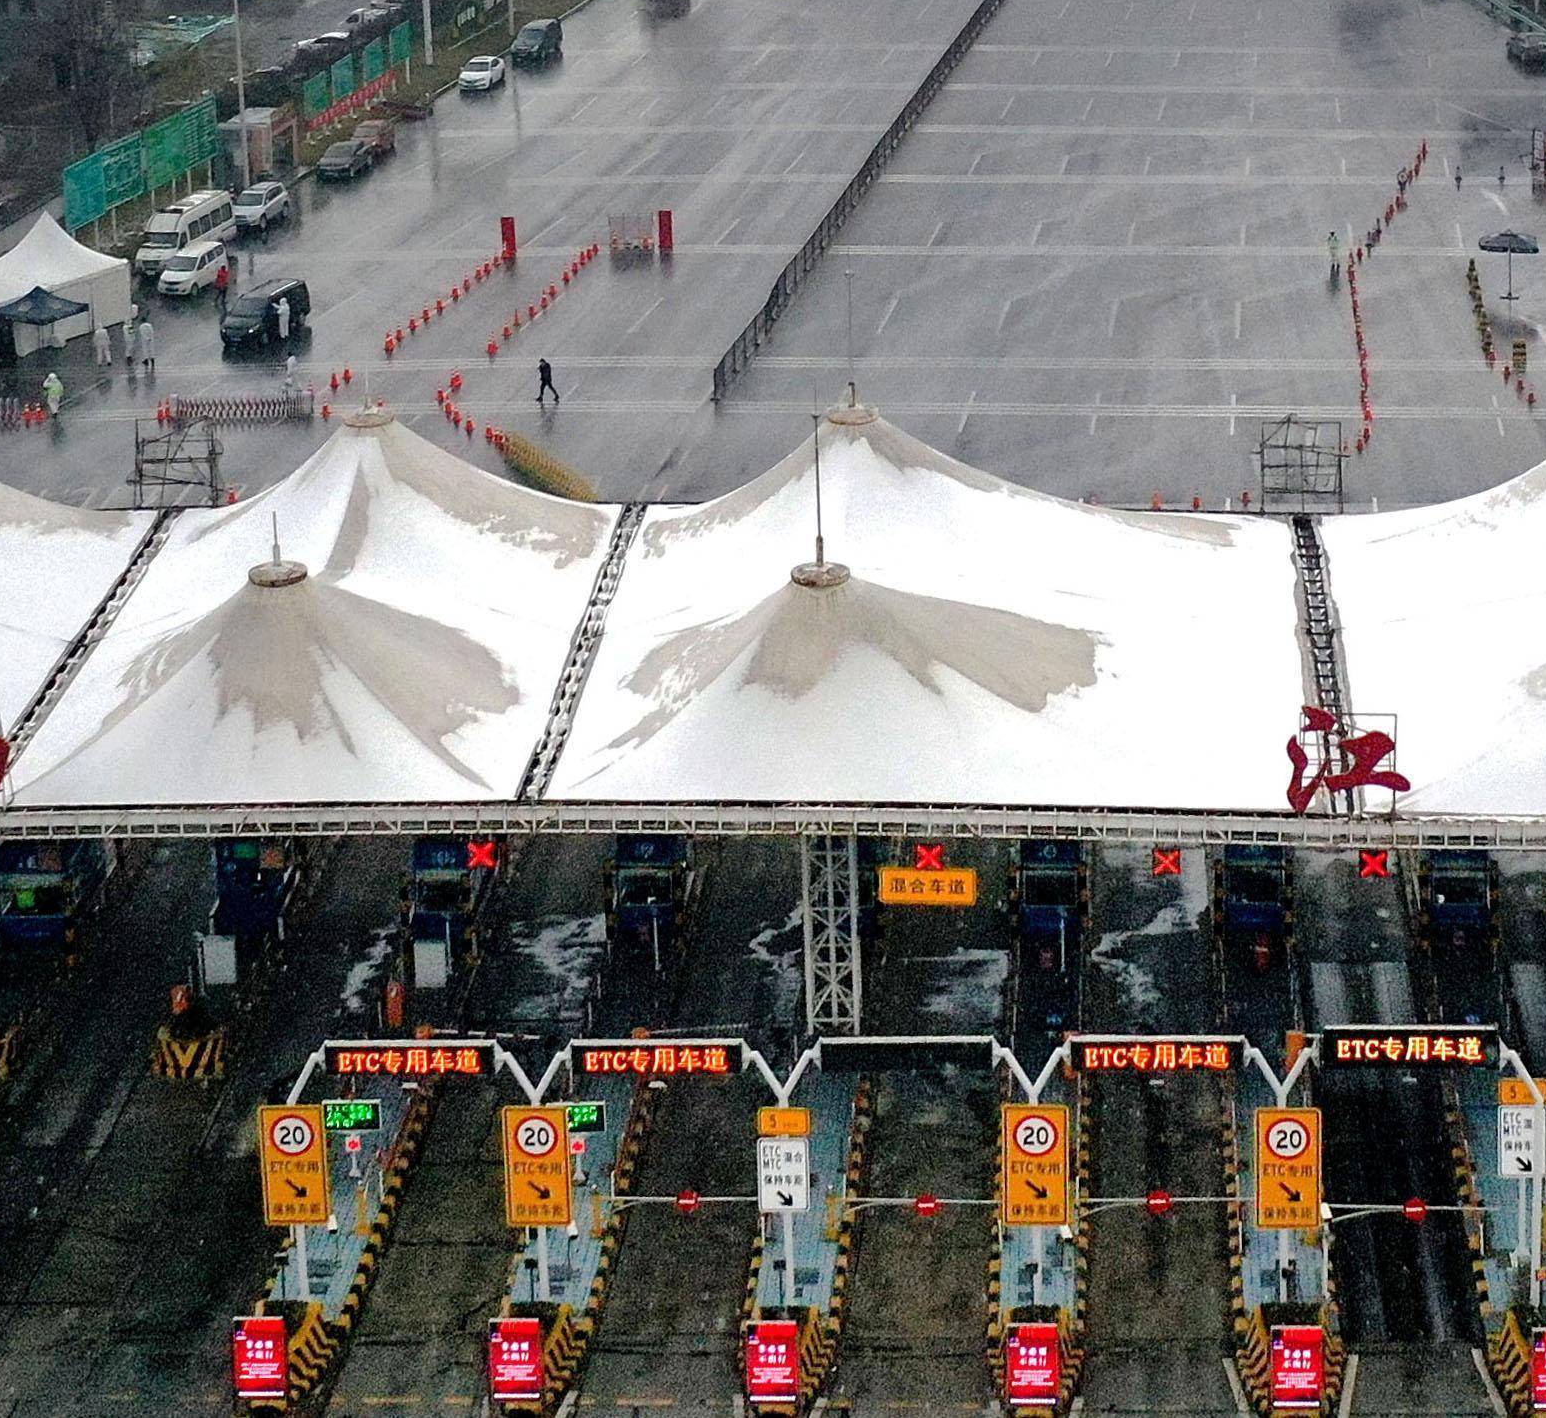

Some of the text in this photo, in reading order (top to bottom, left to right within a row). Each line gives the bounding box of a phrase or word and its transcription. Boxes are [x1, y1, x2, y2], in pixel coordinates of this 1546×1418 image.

[1287, 705, 1411, 814] 江
[890, 878, 965, 894] 混合车道
[1084, 1044, 1230, 1069] ETC专用车道
[1337, 1036, 1482, 1061] ETC专用车道
[338, 1048, 481, 1073] ETC专用车道
[585, 1048, 728, 1073] ETC专用车道
[1503, 1112, 1521, 1124] ETC
[280, 1126, 305, 1145] 20
[524, 1127, 549, 1146] 20
[1023, 1126, 1049, 1145] 20
[1276, 1129, 1302, 1149] 20
[763, 1145, 781, 1157] ETC
